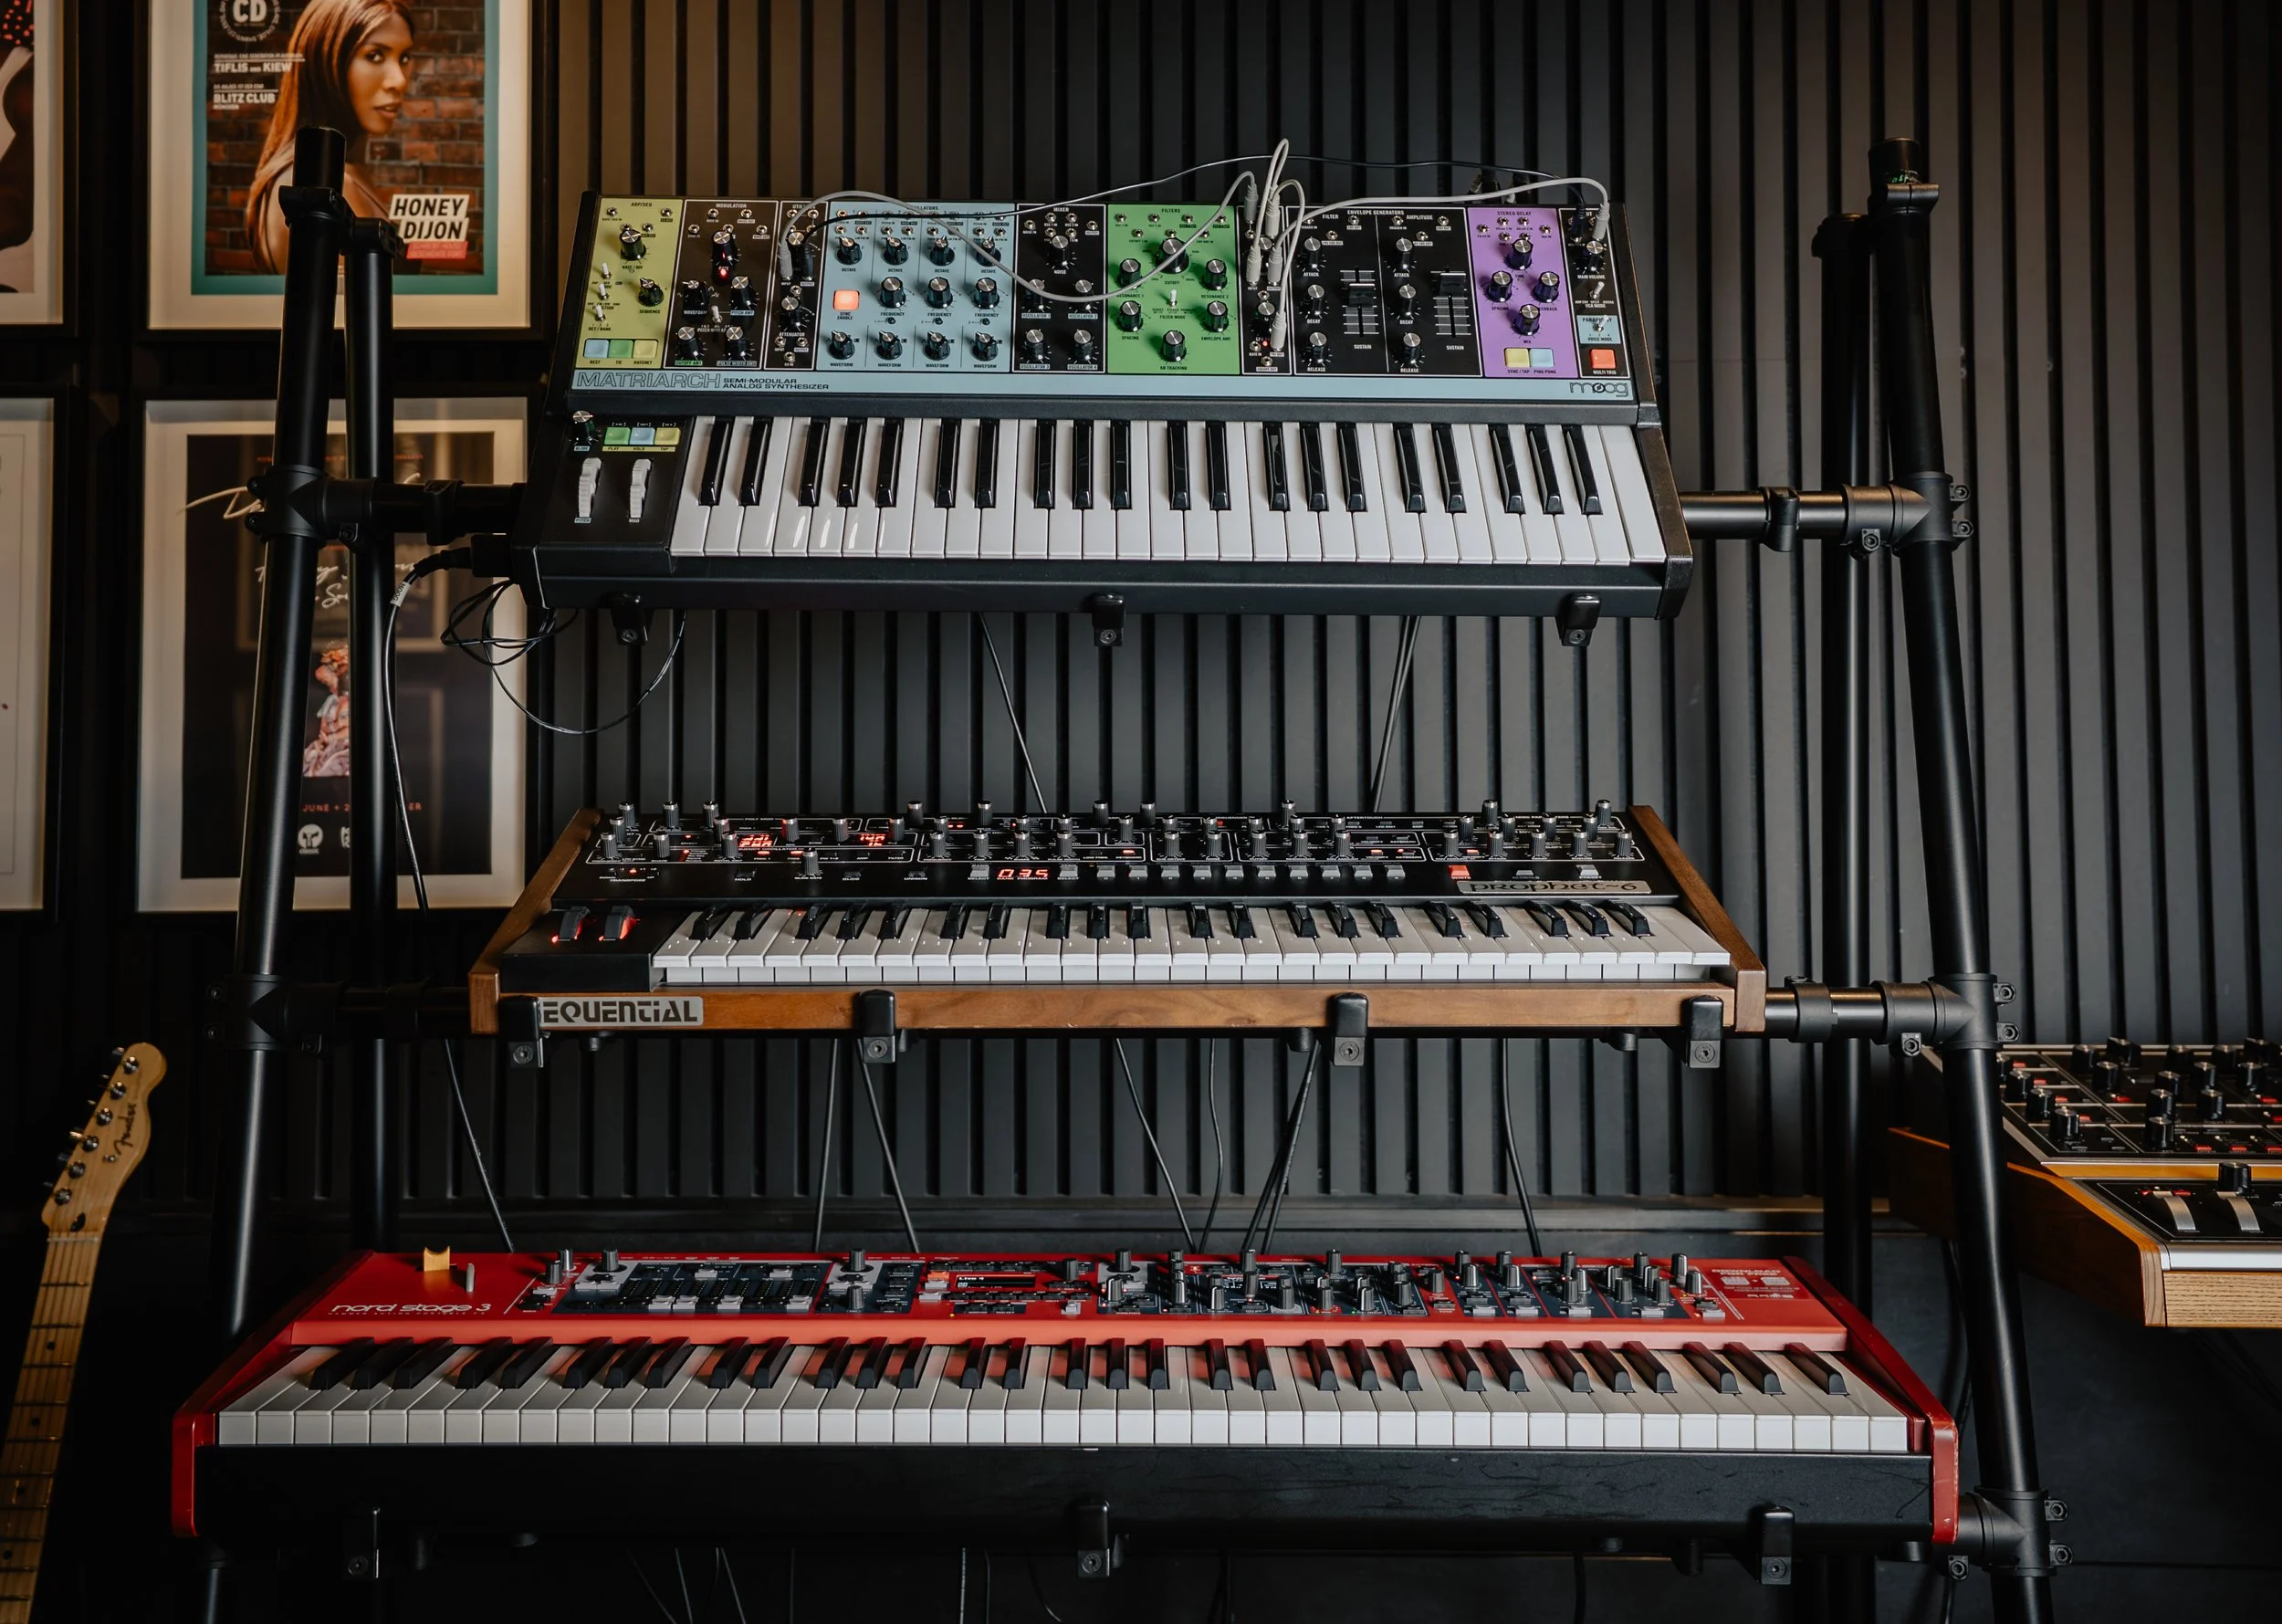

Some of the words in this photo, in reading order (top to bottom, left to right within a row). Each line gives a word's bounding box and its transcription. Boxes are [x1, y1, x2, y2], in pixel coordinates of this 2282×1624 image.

[233, 0, 267, 23] CD
[214, 63, 248, 73] TIFLIS
[263, 63, 293, 73] KIEW
[214, 93, 245, 104] BLITZ
[246, 93, 276, 104] CLUB
[393, 198, 465, 216] HONEY
[403, 221, 463, 239] DIJON
[576, 372, 721, 388] MATRIARCH
[1569, 382, 1629, 397] moog
[393, 583, 406, 602] MOOG
[303, 803, 330, 812] JUNE
[113, 1103, 137, 1156] Fender
[330, 1304, 398, 1312] nord
[399, 1304, 473, 1313] stage
[476, 1303, 492, 1312] 3
